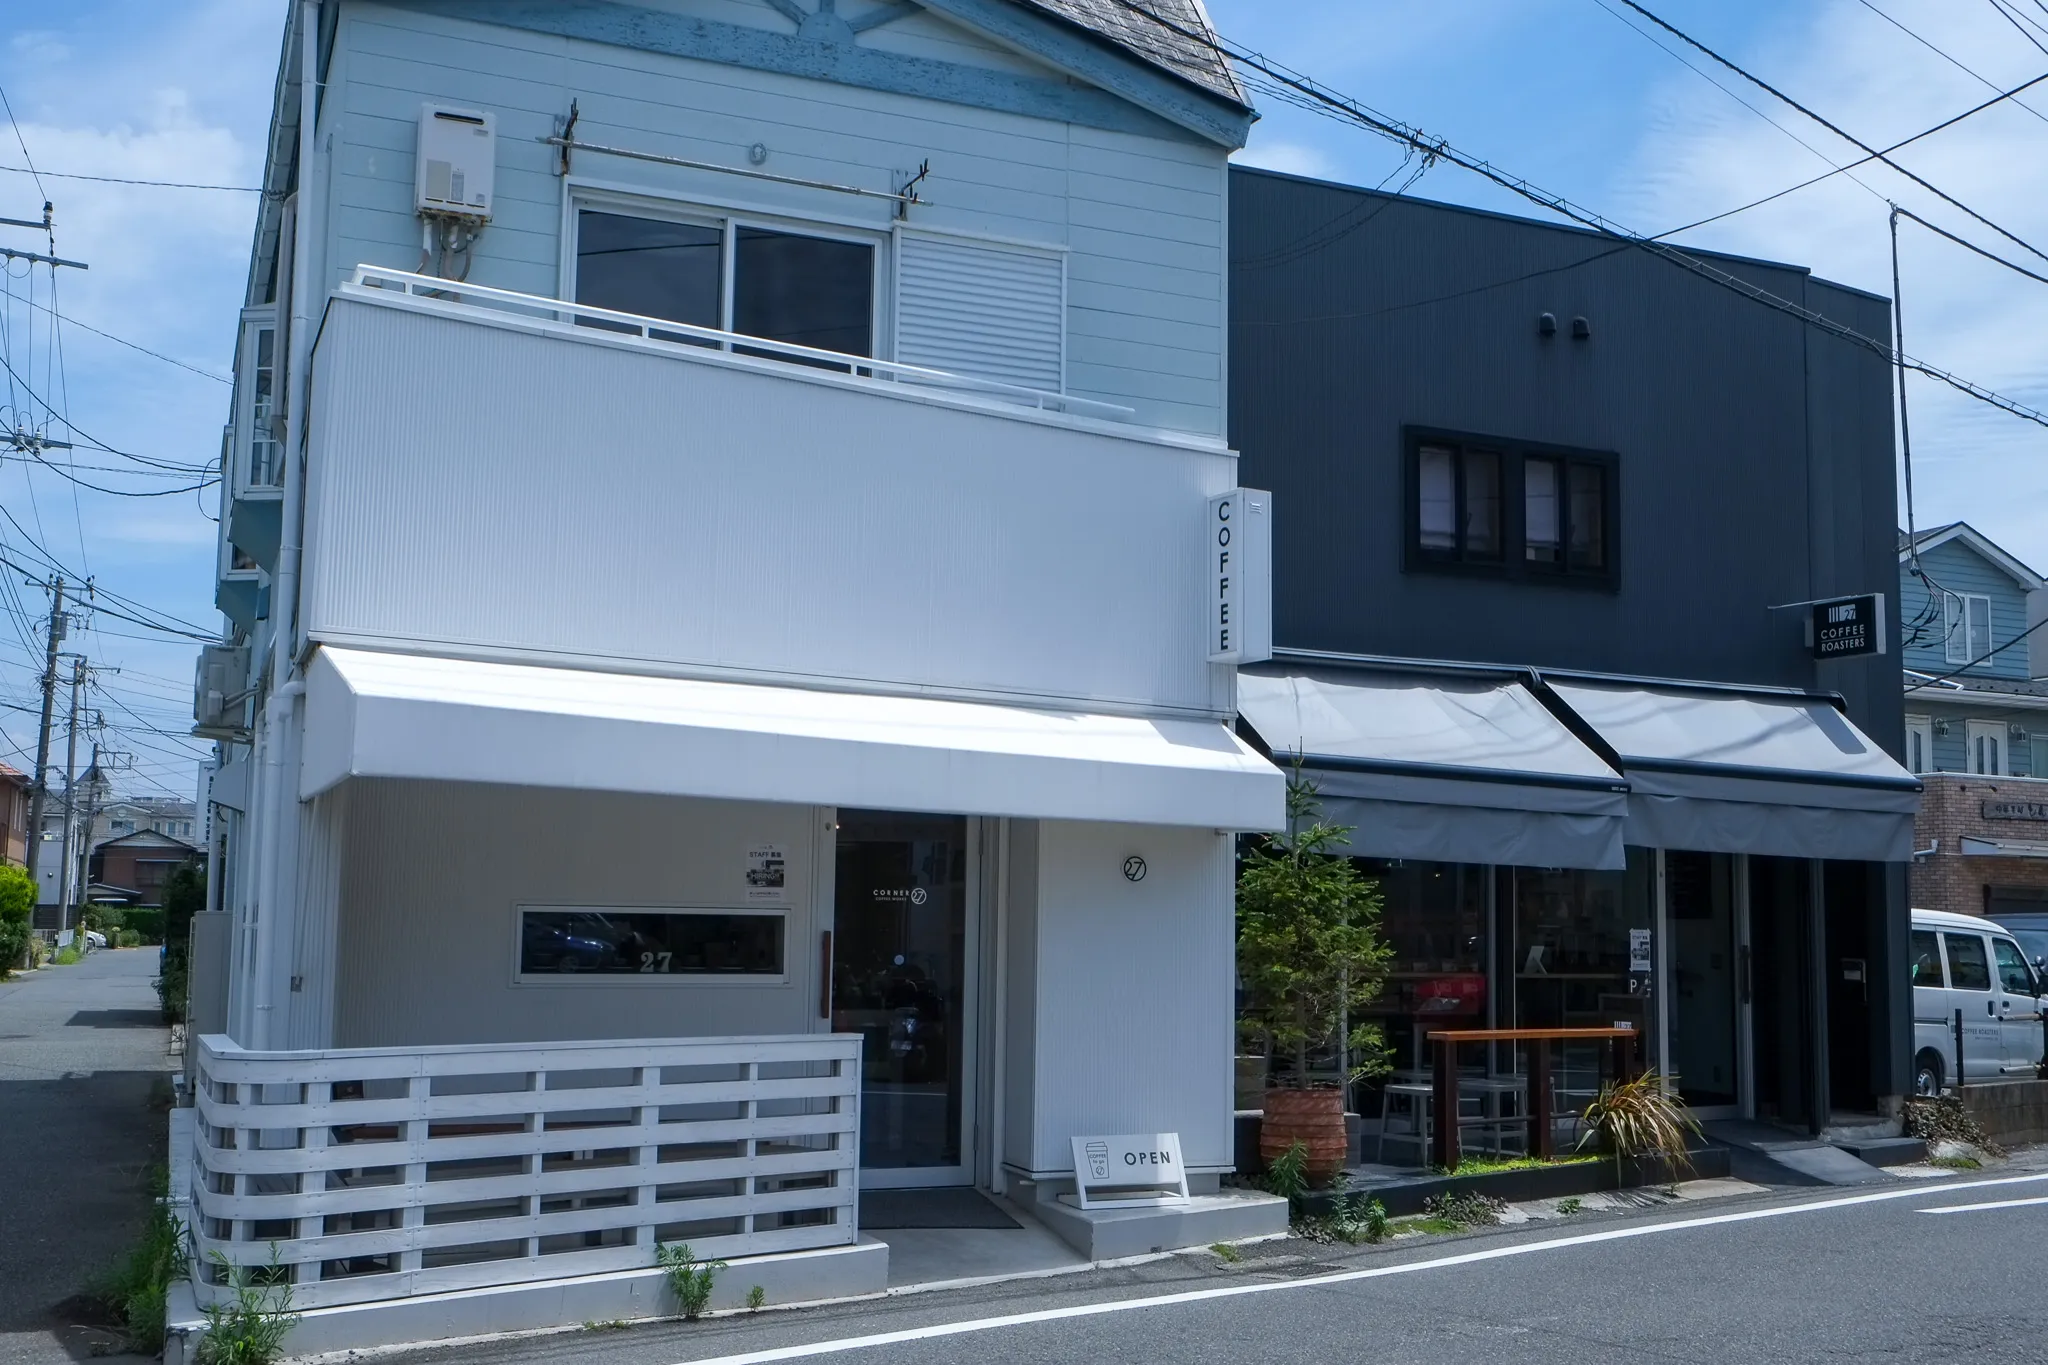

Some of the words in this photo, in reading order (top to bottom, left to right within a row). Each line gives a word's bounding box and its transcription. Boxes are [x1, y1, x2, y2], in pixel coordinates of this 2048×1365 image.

[1218, 501, 1230, 650] COFFEE
[1820, 624, 1864, 639] COFFEE
[1821, 638, 1865, 652] ROASTERS
[1124, 858, 1145, 881] 27
[912, 889, 925, 903] 27
[640, 952, 673, 973] 27
[1124, 1151, 1171, 1165] OPEN
